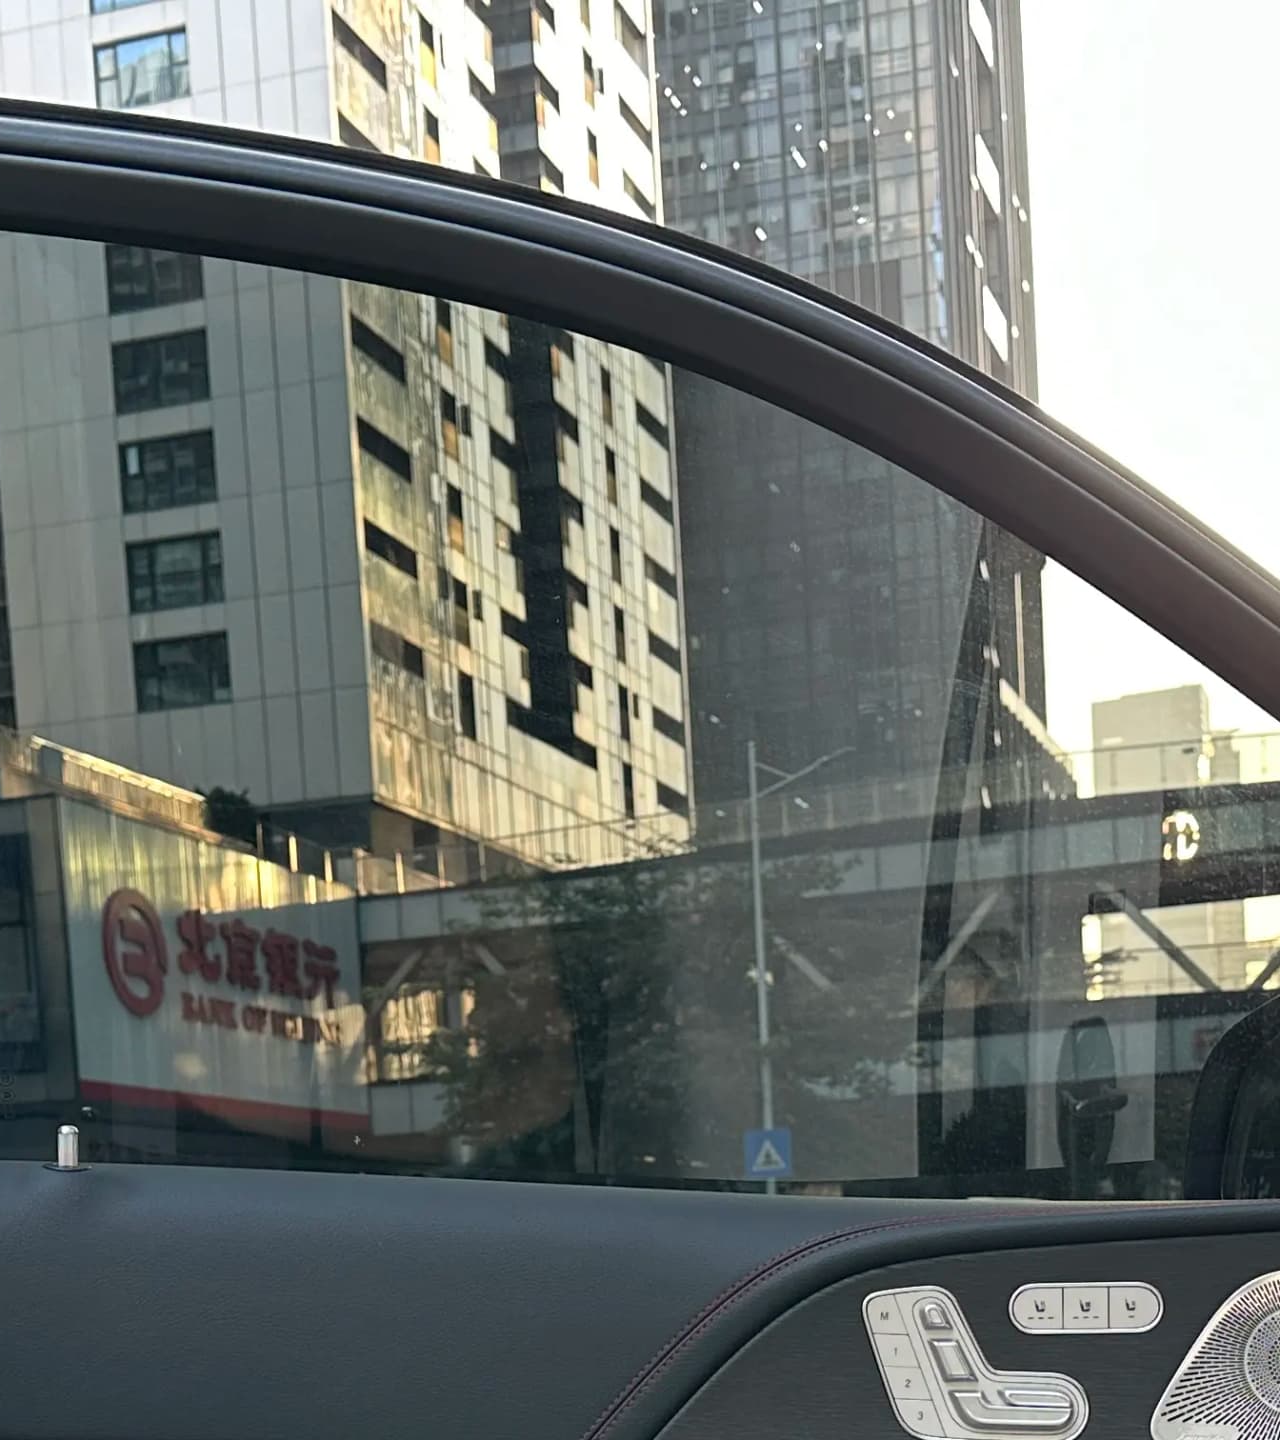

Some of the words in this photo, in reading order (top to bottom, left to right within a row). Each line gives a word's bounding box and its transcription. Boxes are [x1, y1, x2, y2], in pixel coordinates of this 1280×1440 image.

[181, 991, 237, 1030] BANK
[242, 1004, 267, 1035] OF
[880, 1311, 889, 1321] M
[904, 1379, 911, 1388] 2
[917, 1411, 924, 1421] 3
